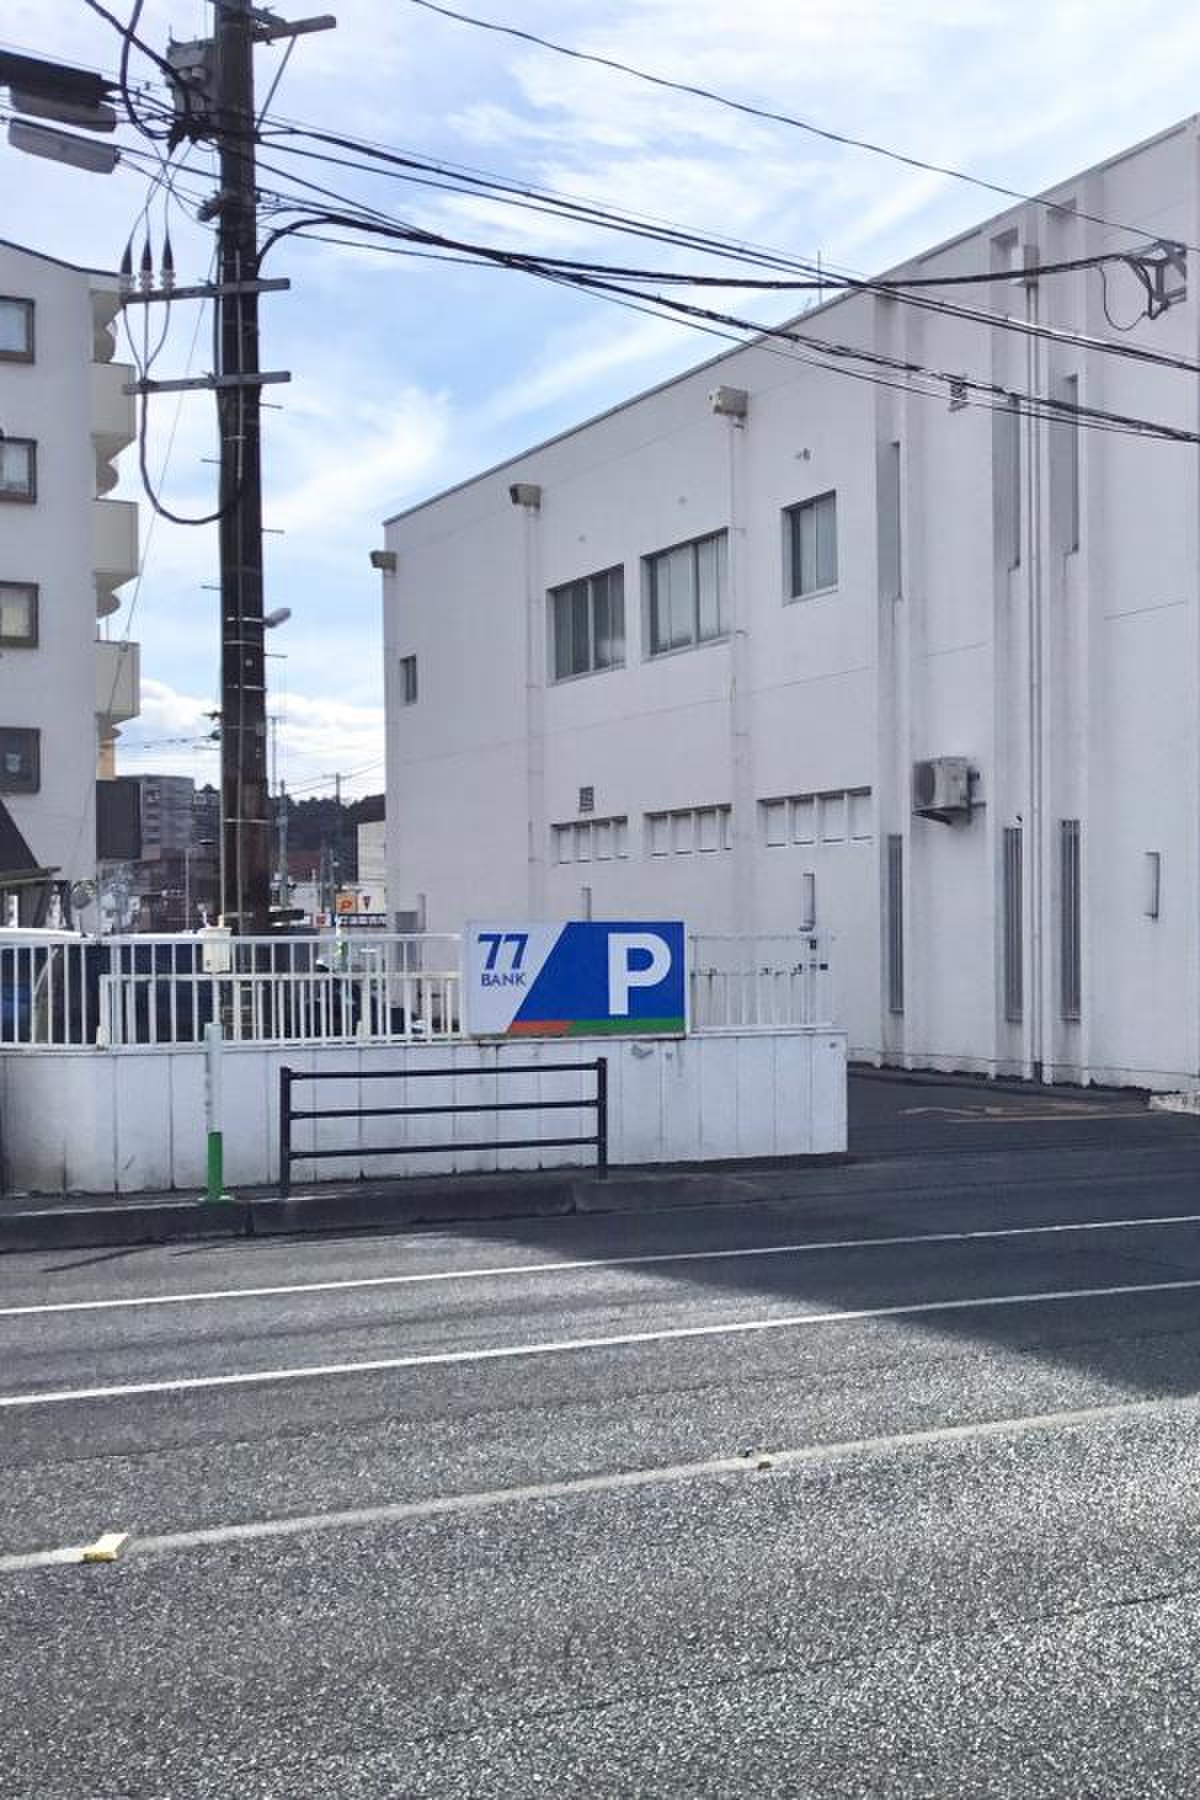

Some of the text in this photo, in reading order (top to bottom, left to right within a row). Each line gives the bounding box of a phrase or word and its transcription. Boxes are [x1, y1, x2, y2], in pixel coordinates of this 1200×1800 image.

[478, 933, 529, 970] 77
[480, 973, 527, 987] BANK
[607, 932, 672, 1015] P
